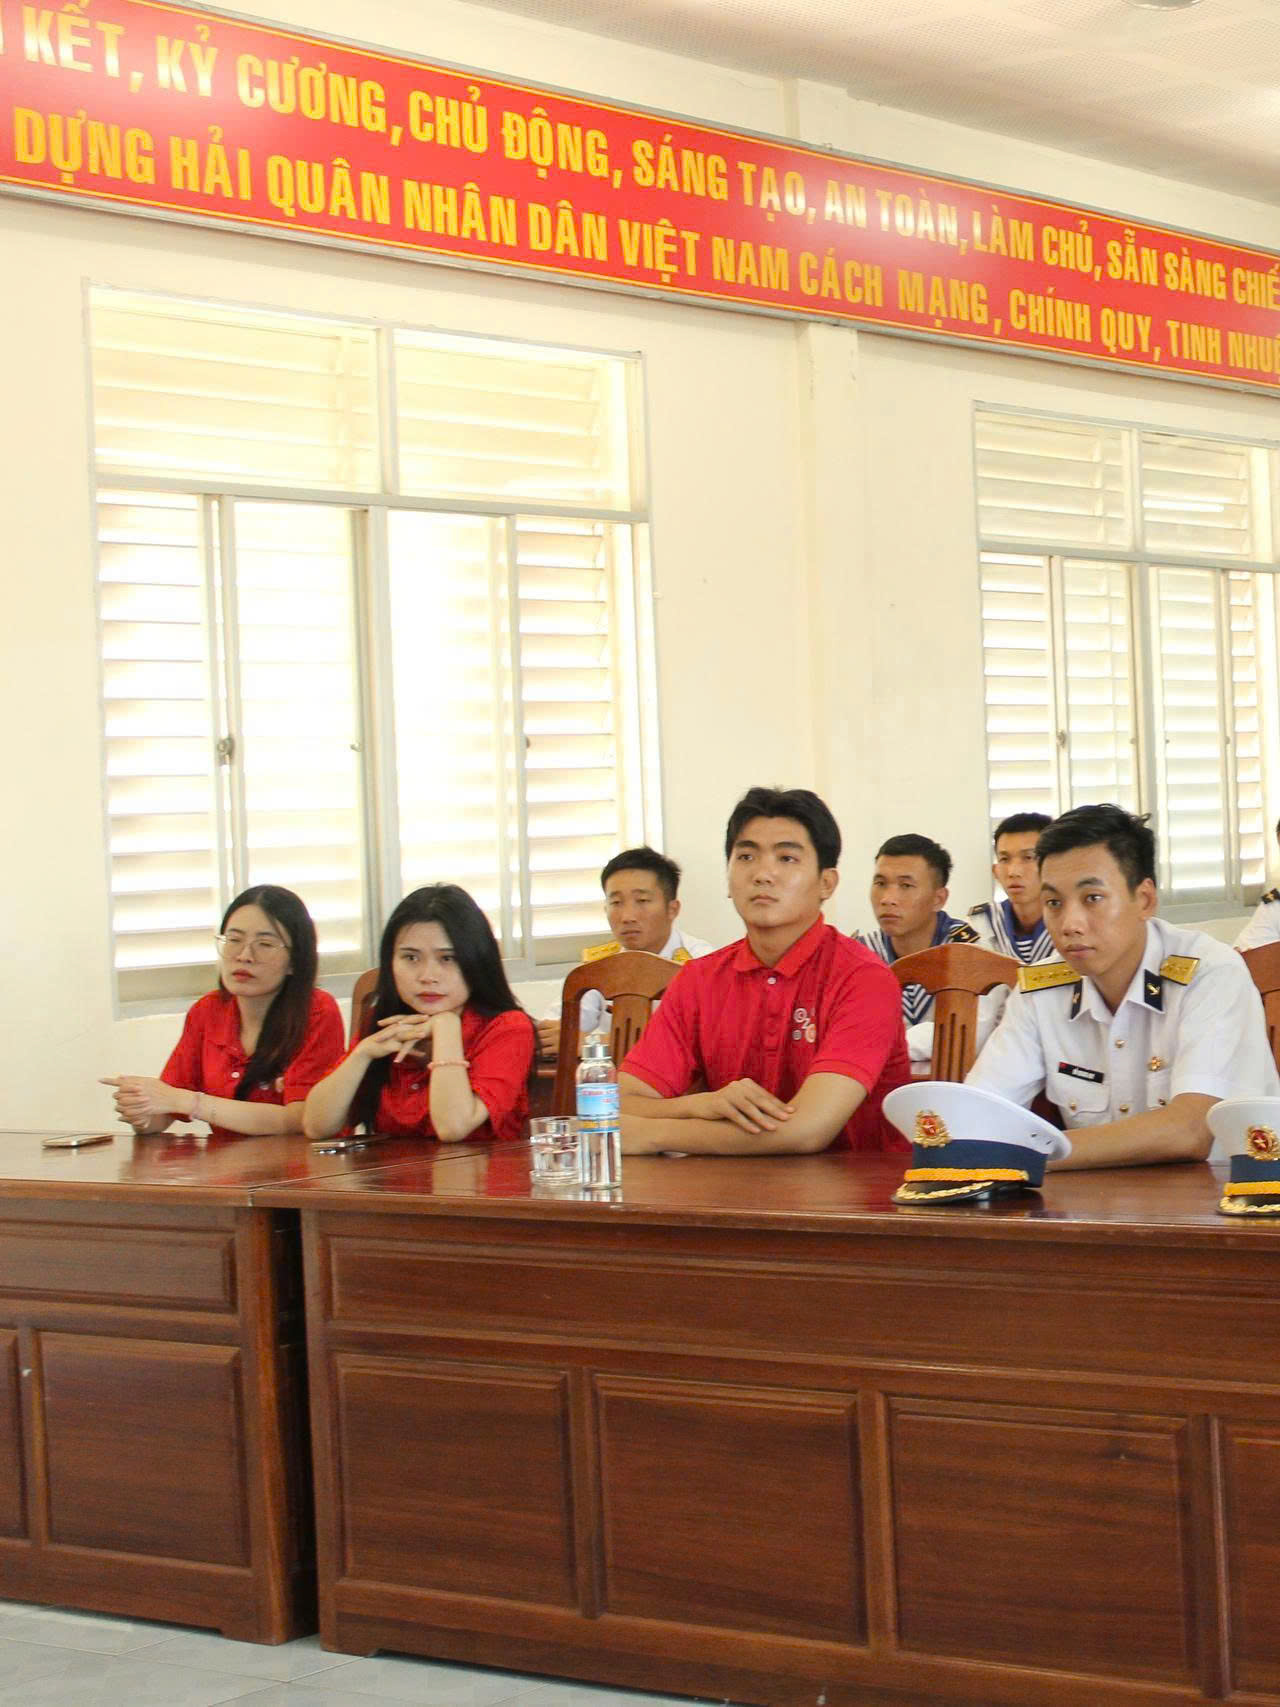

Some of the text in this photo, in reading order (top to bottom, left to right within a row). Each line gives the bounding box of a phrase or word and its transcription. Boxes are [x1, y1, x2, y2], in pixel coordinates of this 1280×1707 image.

[14, 106, 156, 185] DỰNG
[170, 125, 251, 202] HẢI
[267, 157, 391, 226] QUÂN
[403, 181, 518, 246] NHÂN
[528, 200, 608, 262] DÂN
[618, 218, 700, 283] VIỆT
[712, 236, 790, 292] NAM
[799, 248, 883, 307] CÁCH
[1009, 286, 1092, 343] CHÍNH
[1100, 308, 1161, 362] QUY,
[1166, 320, 1222, 364] TINH
[24, 0, 144, 93] KẾT,
[156, 25, 217, 97] KỶ
[236, 54, 402, 147] CƯƠNG,
[408, 86, 489, 154] CHỦ
[501, 106, 623, 189] ĐỘNG,
[633, 134, 728, 201] SÁNG
[737, 162, 816, 224] TẠO,
[824, 179, 867, 228] AN
[875, 188, 969, 256] TOÀN,
[972, 205, 1035, 261] LÀM
[1042, 220, 1101, 281] CHỦ,
[1164, 246, 1226, 300] SÀNG
